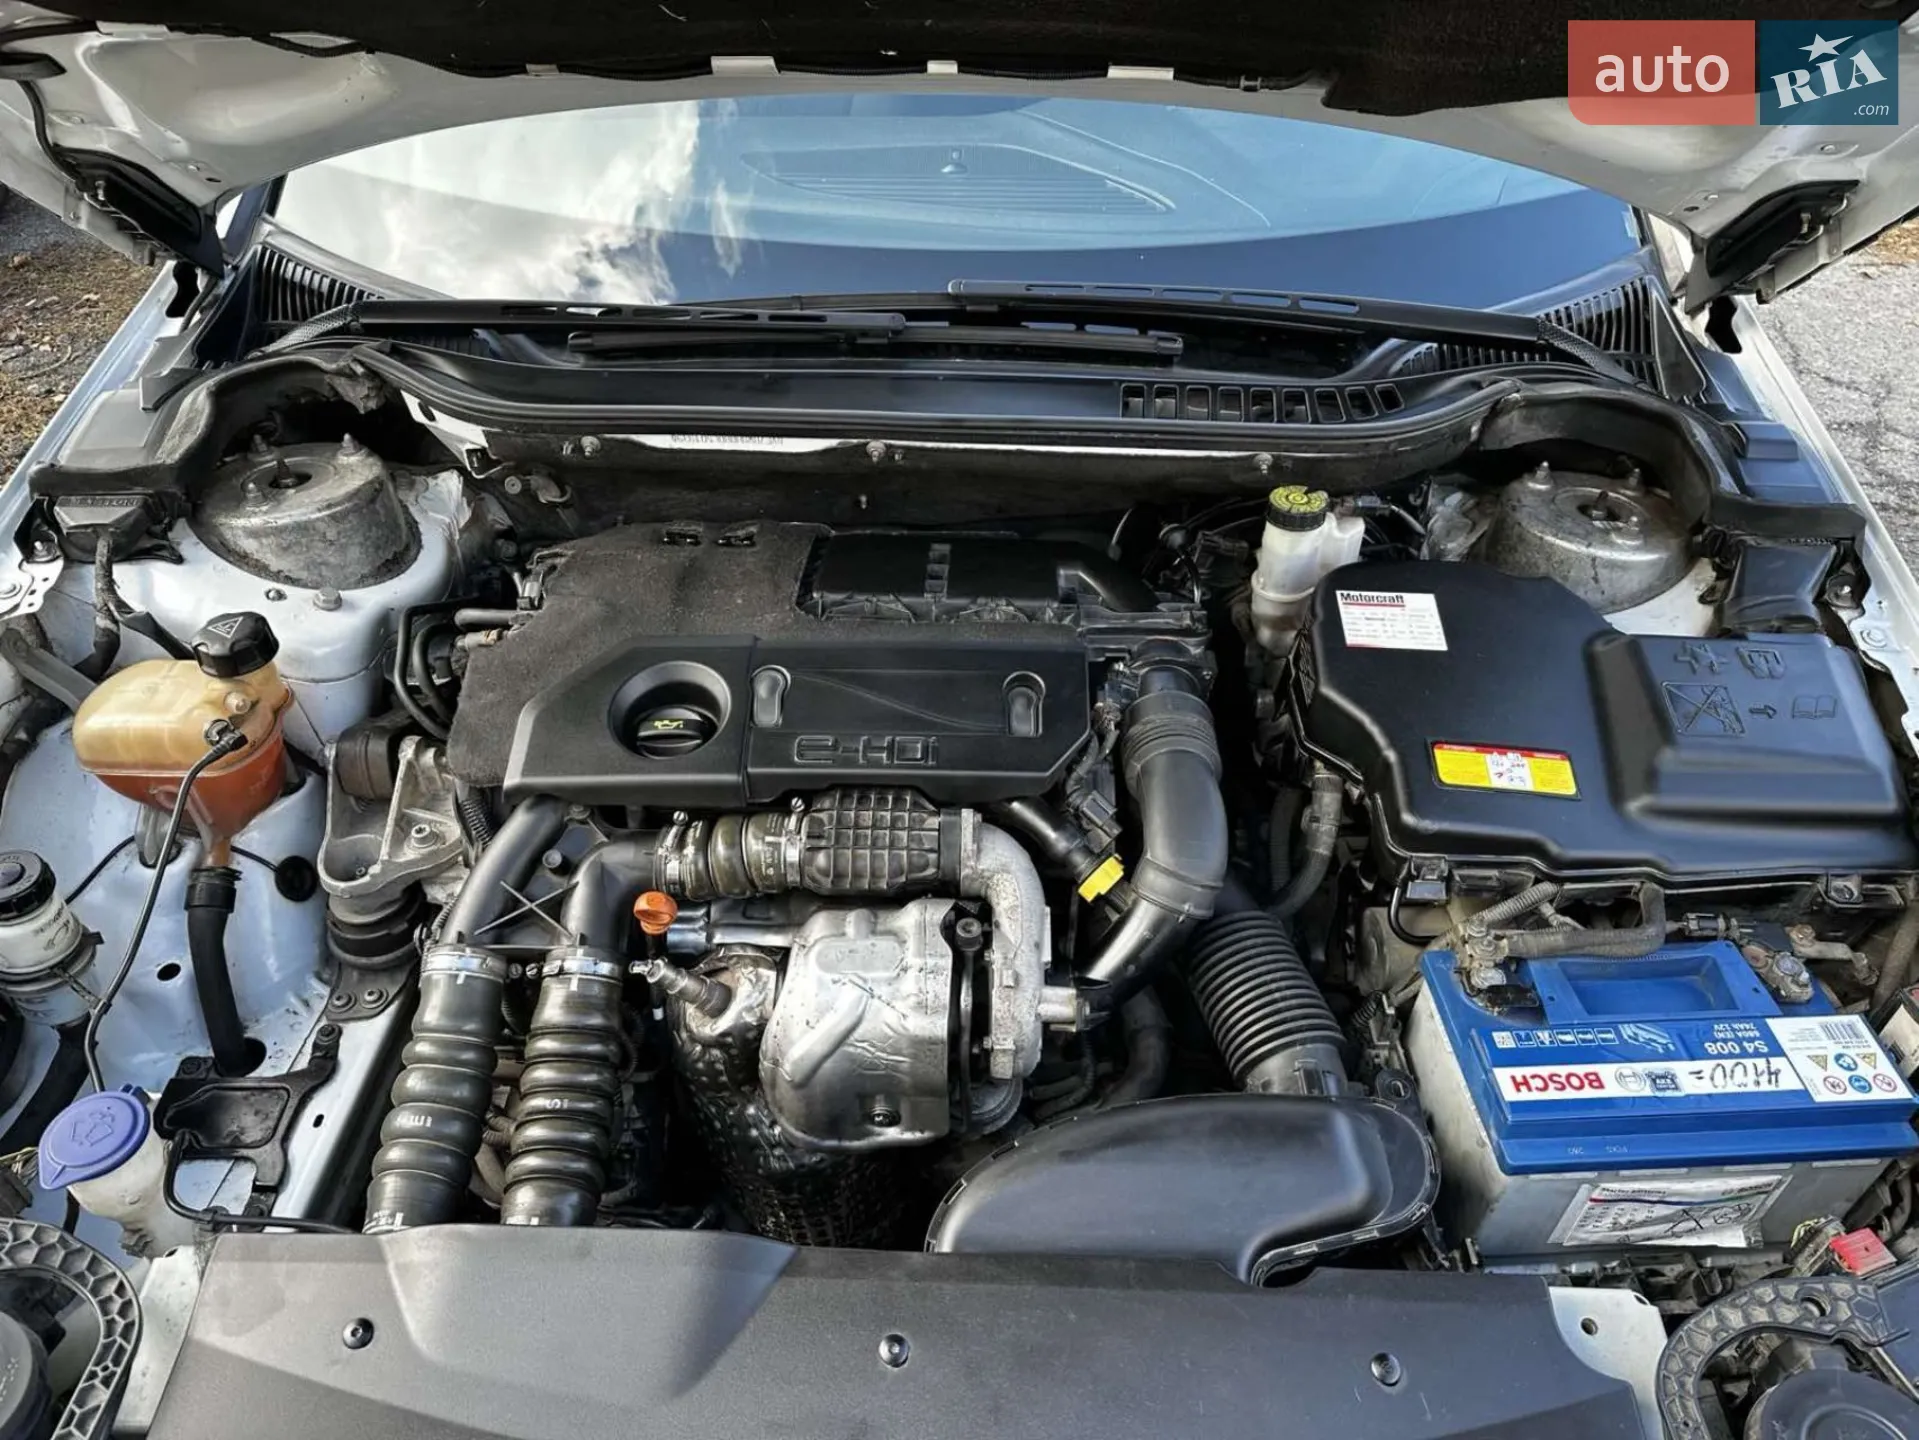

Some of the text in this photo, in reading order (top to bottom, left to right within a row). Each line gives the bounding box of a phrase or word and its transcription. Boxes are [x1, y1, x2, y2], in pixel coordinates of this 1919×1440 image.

[1339, 592, 1405, 604] Motorcraft
[1703, 1040, 1769, 1055] S4 008
[1510, 1071, 1605, 1093] BOSCH
